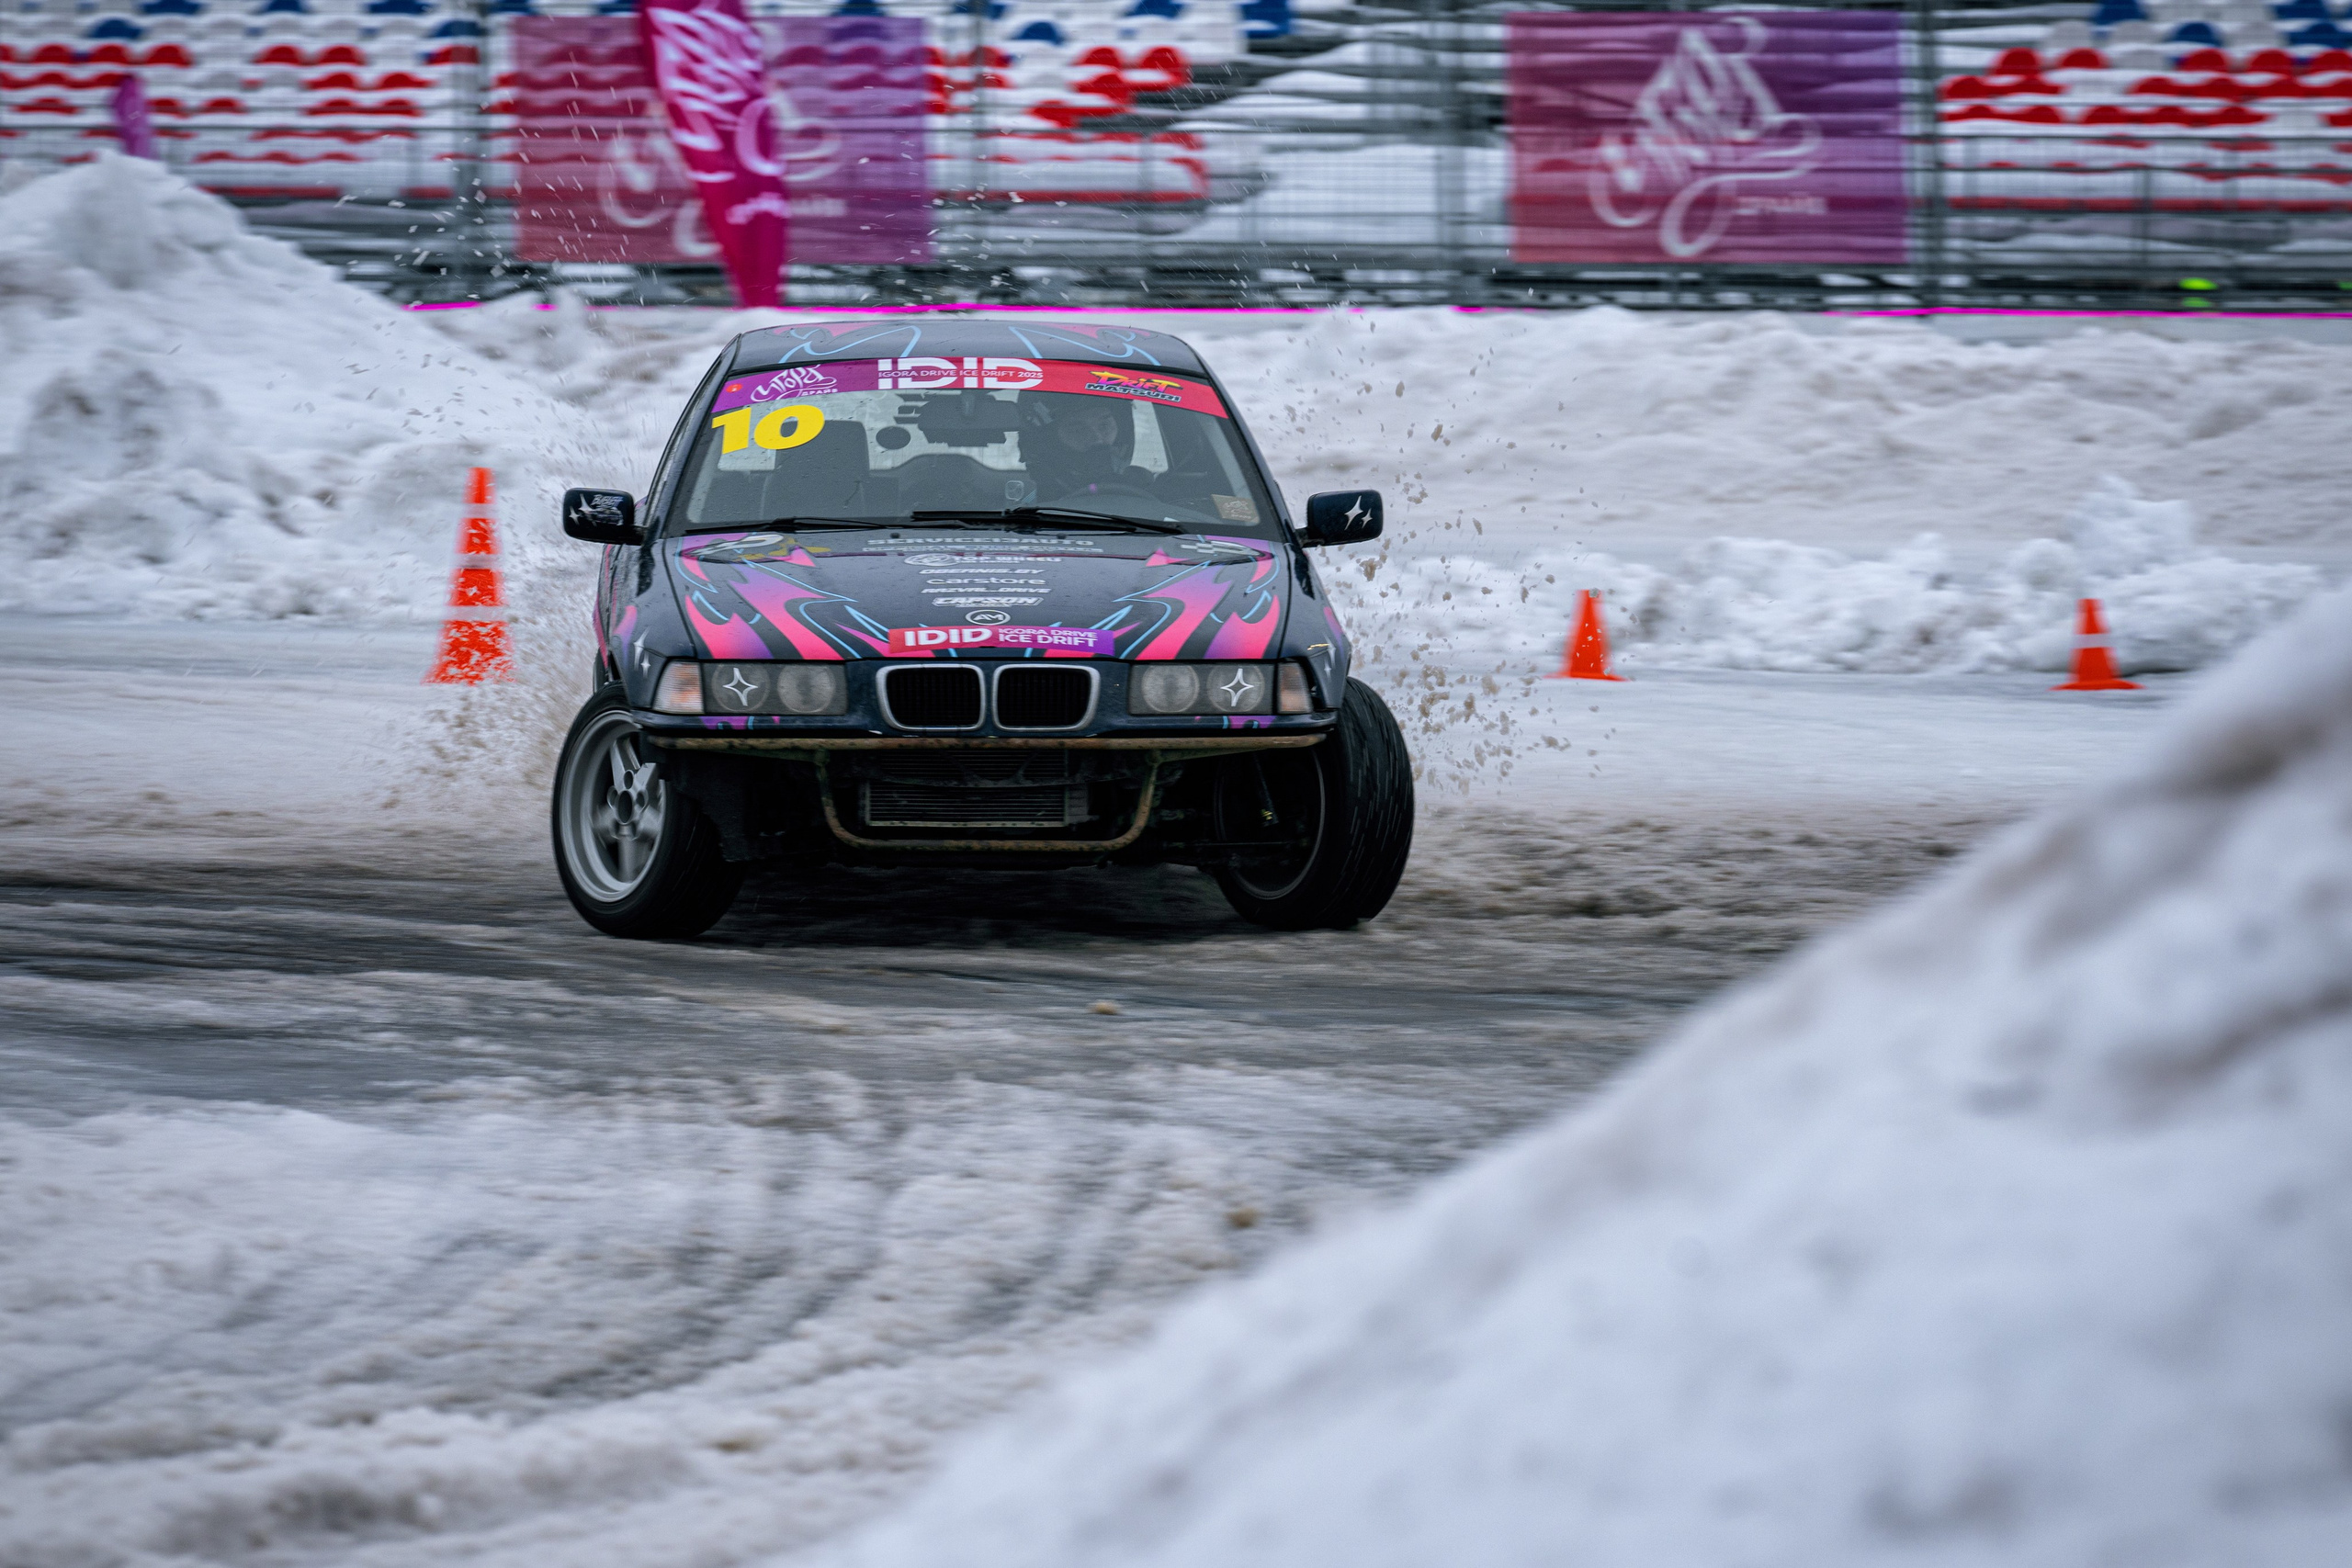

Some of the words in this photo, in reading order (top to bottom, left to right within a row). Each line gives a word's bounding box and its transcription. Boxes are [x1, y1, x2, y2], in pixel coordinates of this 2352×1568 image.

[877, 356, 1044, 389] IDID
[878, 370, 919, 378] IGORA
[920, 369, 956, 378] DRIVE
[959, 369, 979, 378] ICE
[980, 369, 1015, 378] DRIFT
[1017, 370, 1044, 379] 2025
[801, 388, 838, 397] ДРАЙВ
[1084, 382, 1182, 402] MATSURI
[711, 404, 825, 455] 10
[926, 577, 1046, 585] carstore
[904, 627, 993, 647] IDID
[999, 627, 1047, 636] IGORA
[1050, 628, 1098, 638] DRIVE
[999, 634, 1033, 644] ICE
[1036, 634, 1098, 648] DRIFT
